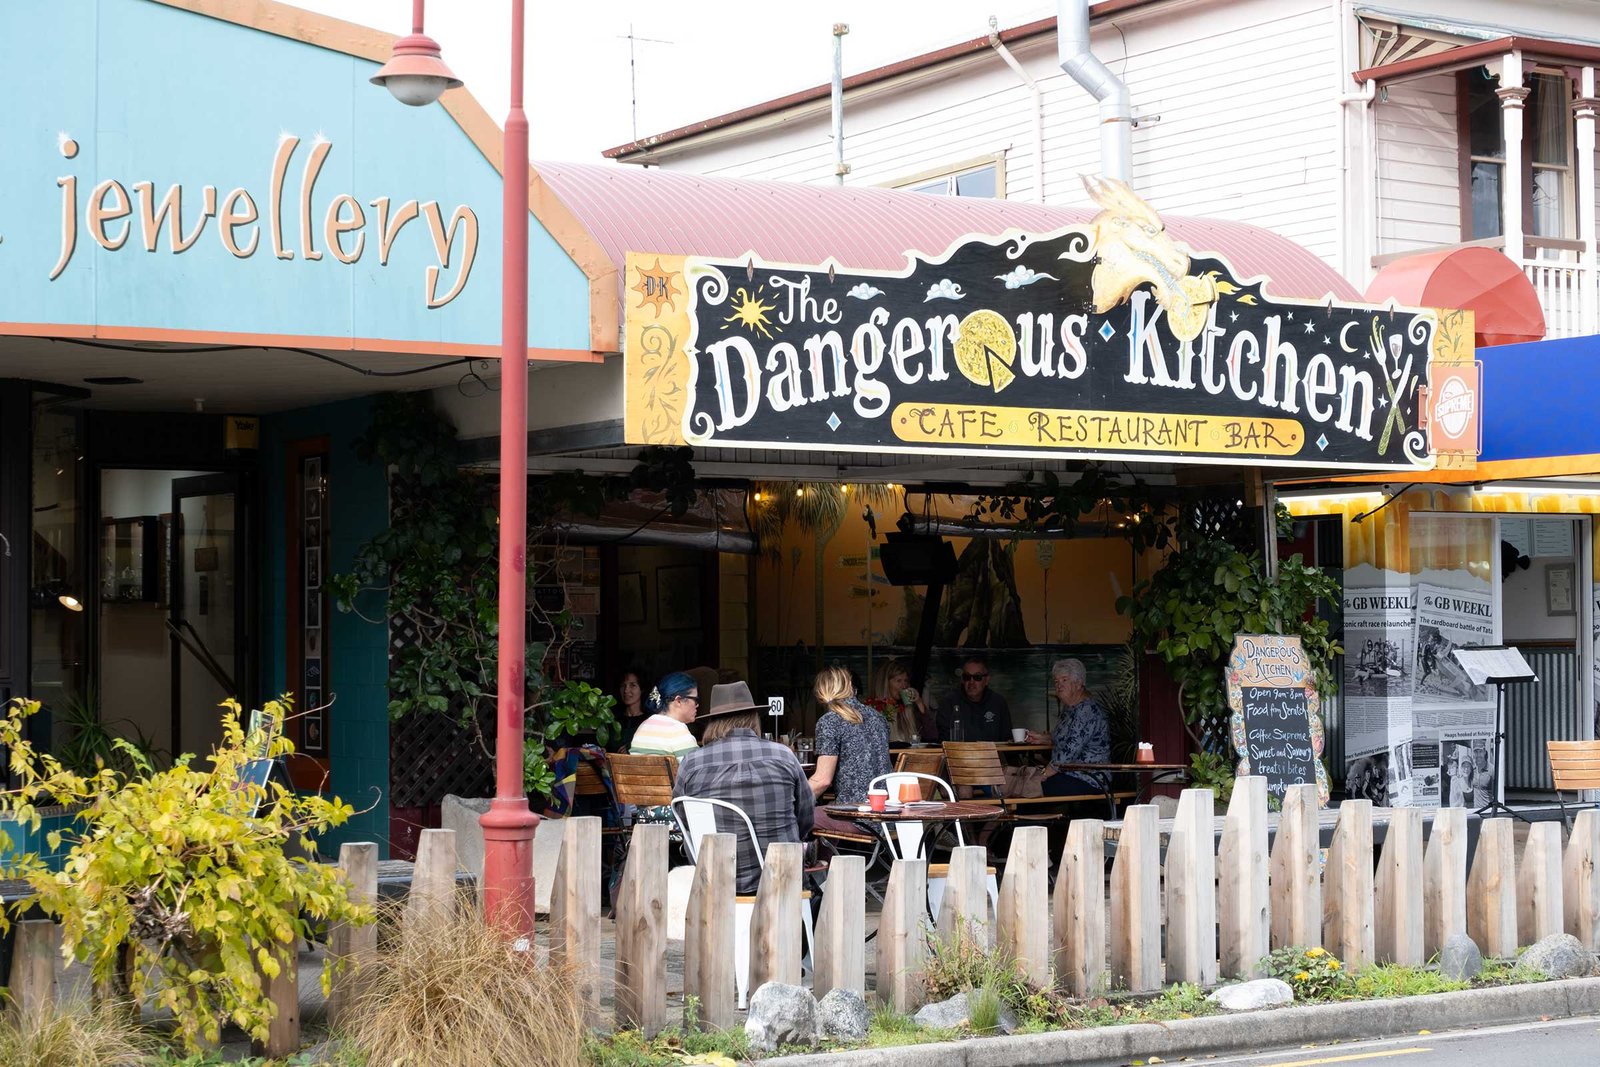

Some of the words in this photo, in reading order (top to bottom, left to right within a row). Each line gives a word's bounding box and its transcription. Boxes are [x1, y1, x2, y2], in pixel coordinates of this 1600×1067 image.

[49, 136, 479, 308] jewellery
[769, 274, 842, 325] The
[706, 307, 1088, 432] Dangerous
[1124, 290, 1375, 441] Kitchen
[234, 419, 257, 431] Yale
[909, 407, 1002, 438] CAFE
[1028, 411, 1208, 447] RESTAURANT
[1222, 422, 1292, 448] BAR
[1352, 596, 1368, 610] GB
[1434, 596, 1450, 610] GB
[1357, 619, 1367, 628] raft
[1368, 620, 1380, 628] race
[1420, 616, 1429, 624] The
[1430, 619, 1458, 629] cardboard
[1459, 622, 1475, 631] battle
[1475, 625, 1482, 633] of
[1243, 639, 1299, 664] DANGEROUS
[1248, 658, 1292, 680] KITCHEN
[1250, 687, 1272, 700] Open
[771, 700, 782, 712] 60
[1246, 703, 1269, 720] Food
[1270, 703, 1282, 718] from
[1279, 701, 1307, 720] Scratch
[1249, 728, 1271, 743] Coffee
[1273, 728, 1308, 741] Supreme
[1250, 744, 1276, 760] Sweet
[1276, 748, 1286, 758] and
[1258, 761, 1280, 775] treats
[1287, 761, 1307, 775] bites
